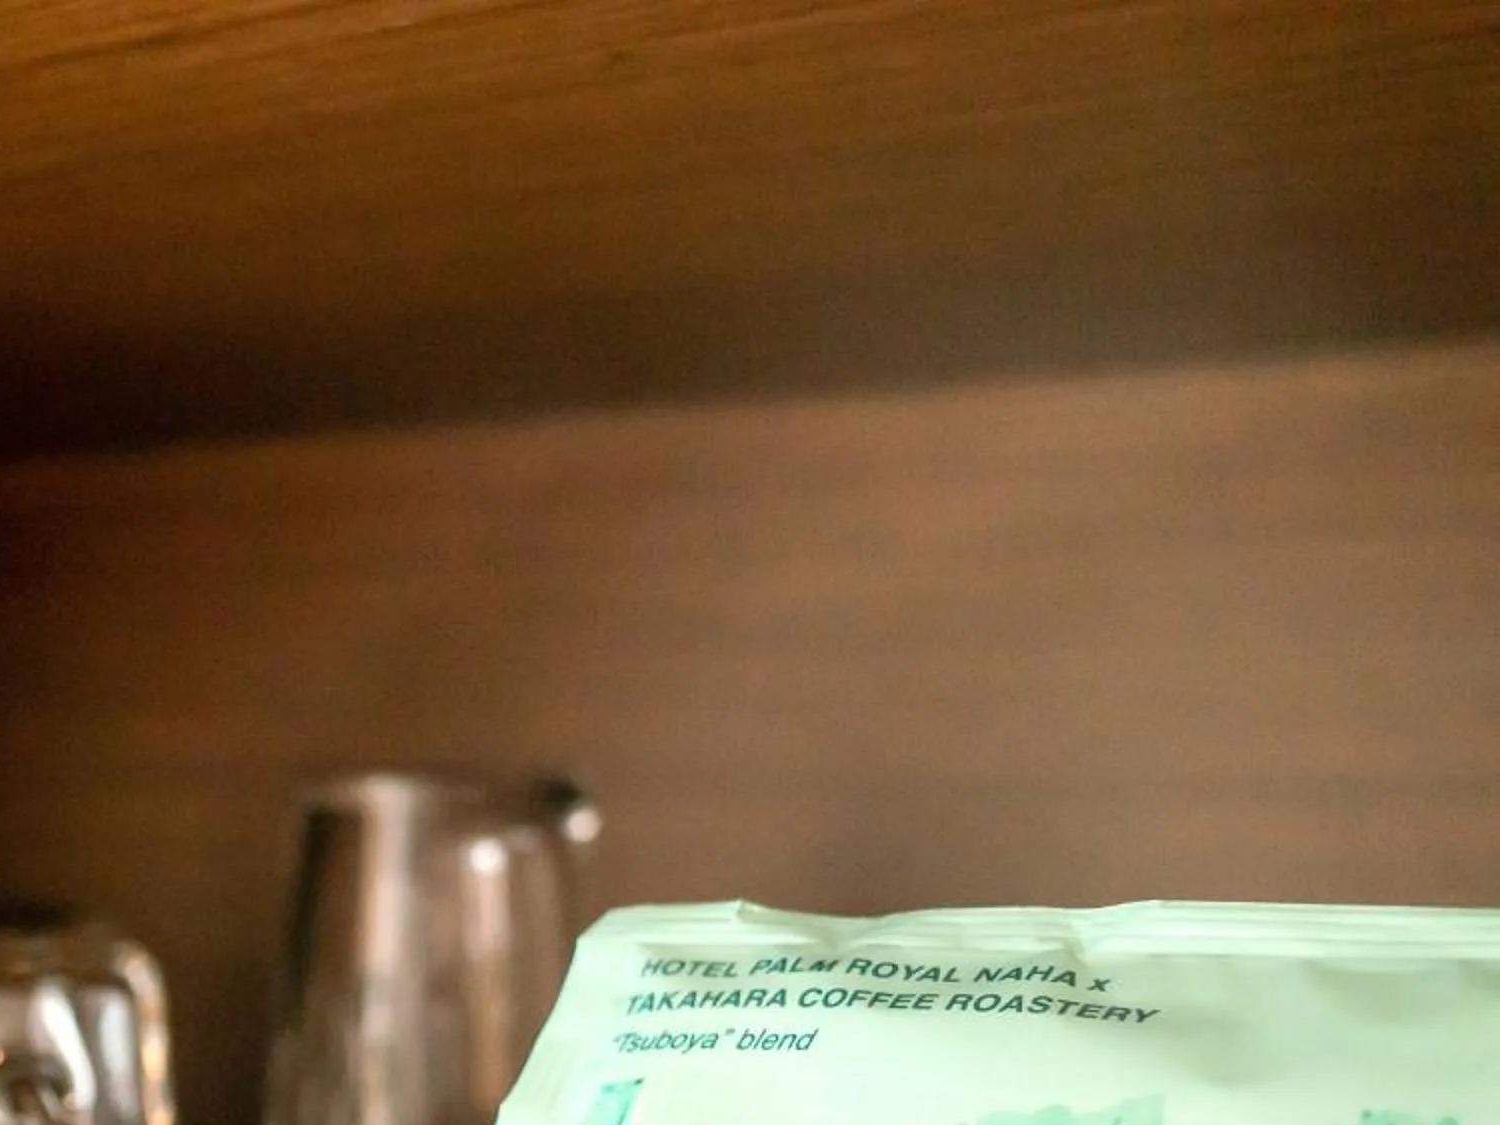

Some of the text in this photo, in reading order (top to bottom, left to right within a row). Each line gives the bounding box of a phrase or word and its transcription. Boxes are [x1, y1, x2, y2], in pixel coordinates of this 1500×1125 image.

[641, 958, 739, 977] HOTEL
[750, 956, 839, 975] PALM
[846, 957, 961, 983] ROYAL
[973, 964, 1077, 988] NAHA
[626, 987, 1162, 1023] TAKAHARA COFFEE ROASTERY
[735, 1027, 820, 1052] blend
